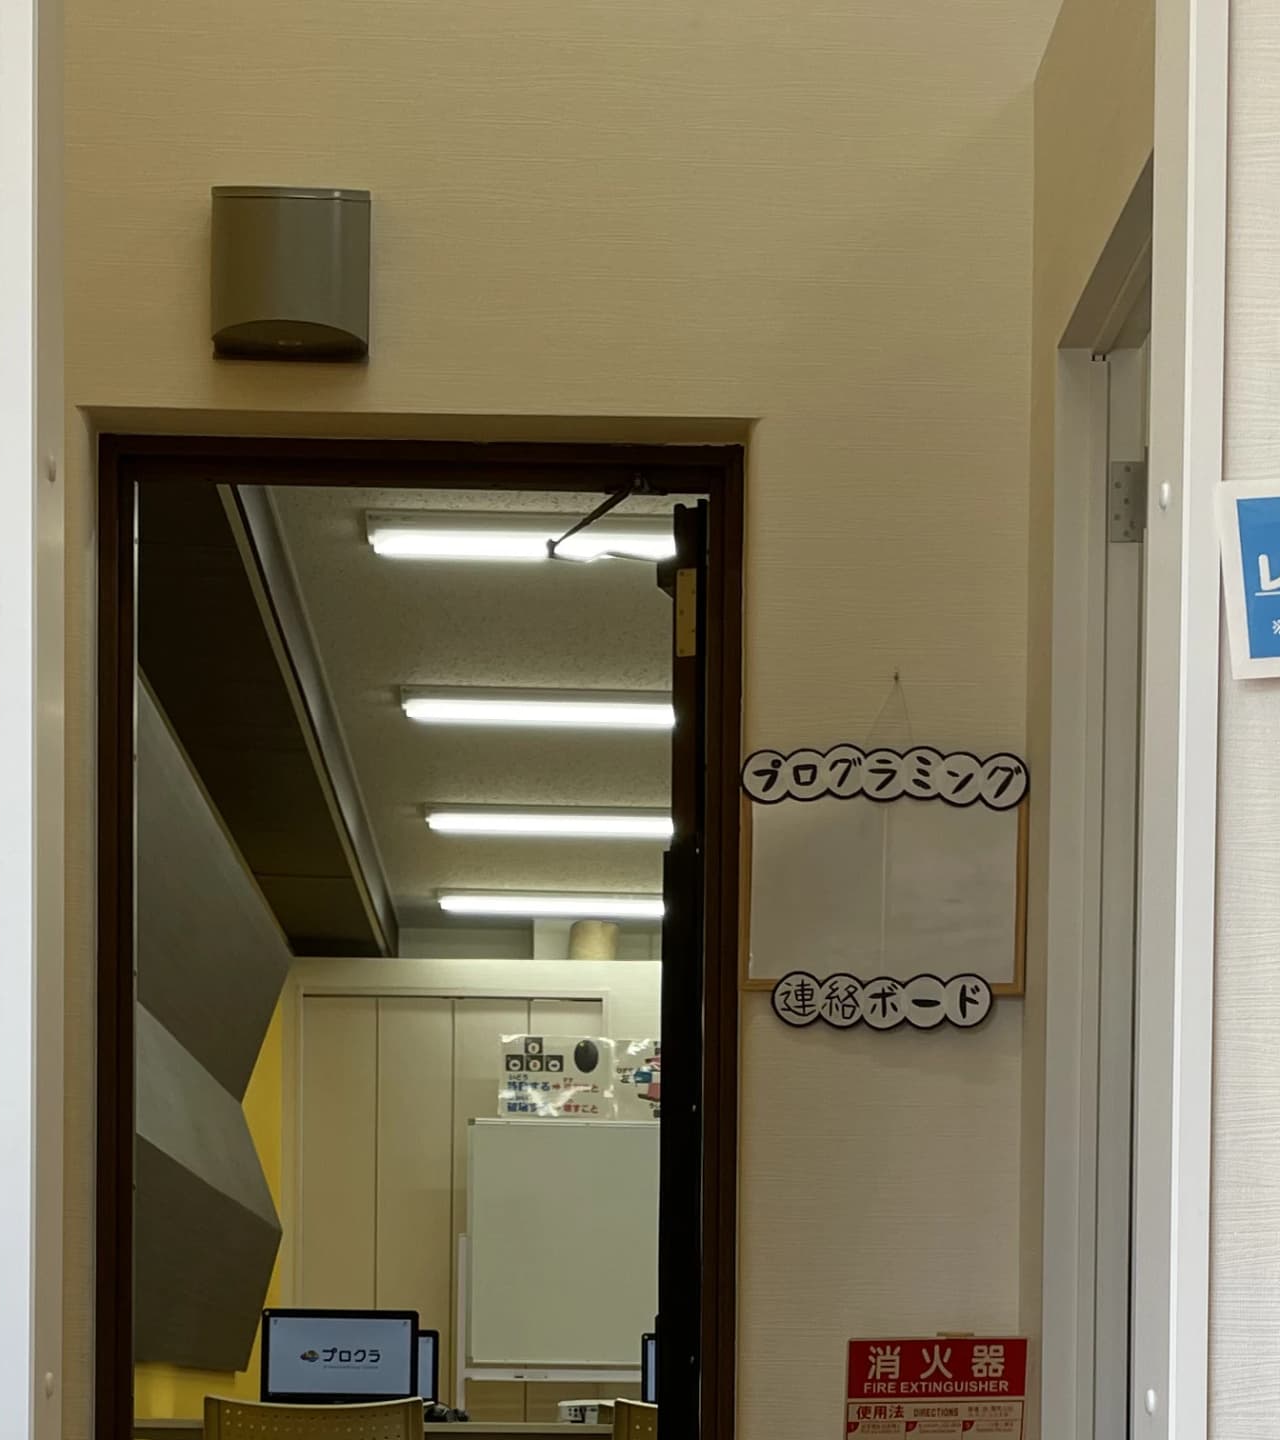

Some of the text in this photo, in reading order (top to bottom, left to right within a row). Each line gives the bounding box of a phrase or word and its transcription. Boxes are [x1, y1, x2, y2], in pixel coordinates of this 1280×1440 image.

[752, 755, 1022, 799] プログラミング
[779, 978, 981, 1019] 連絡ボード
[322, 1347, 381, 1363] プロクラ
[867, 1344, 1005, 1380] 消火器
[864, 1380, 1009, 1394] FIRE EXTINGUISHER
[856, 1405, 905, 1420] 使用法
[913, 1407, 959, 1418] DIRECTIONS
